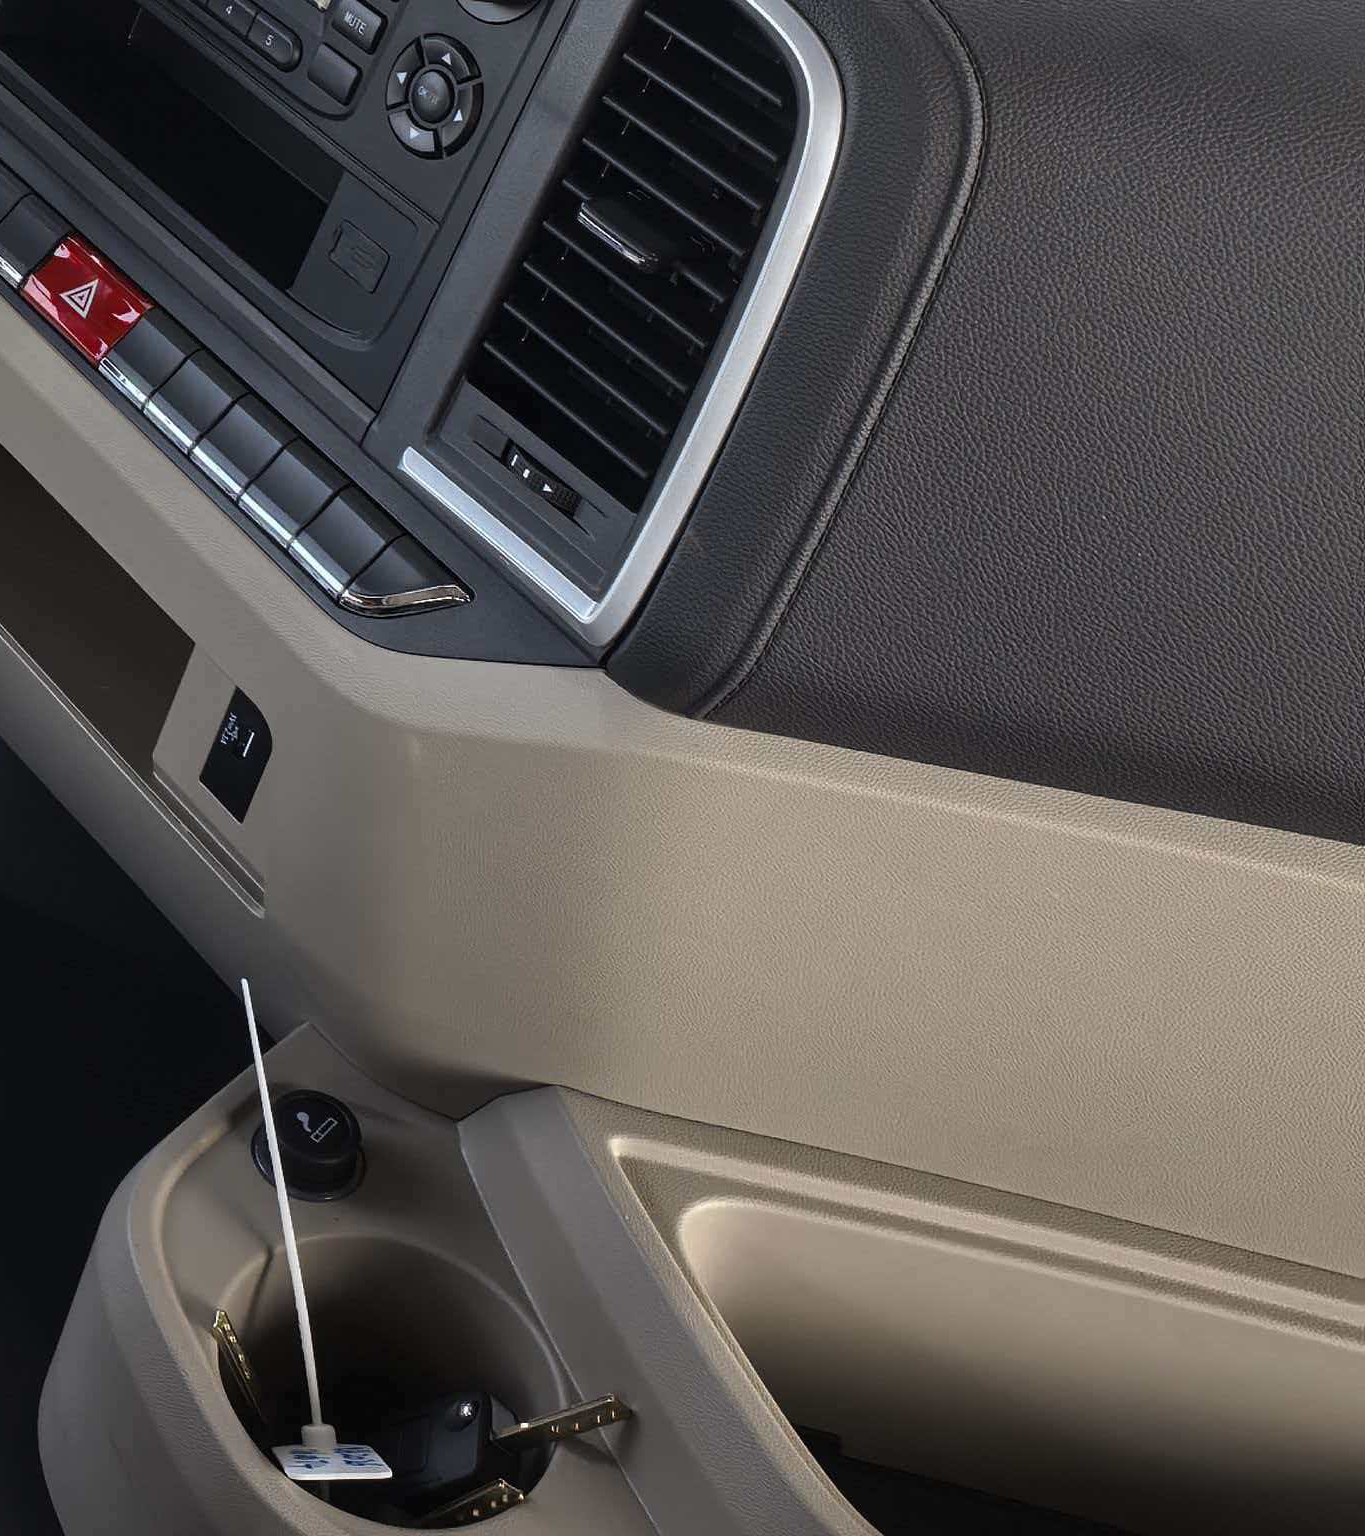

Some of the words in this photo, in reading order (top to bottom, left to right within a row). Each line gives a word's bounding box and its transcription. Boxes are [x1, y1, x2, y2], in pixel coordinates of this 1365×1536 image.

[225, 4, 233, 15] 4
[344, 11, 368, 35] MUTE
[265, 34, 274, 46] 5
